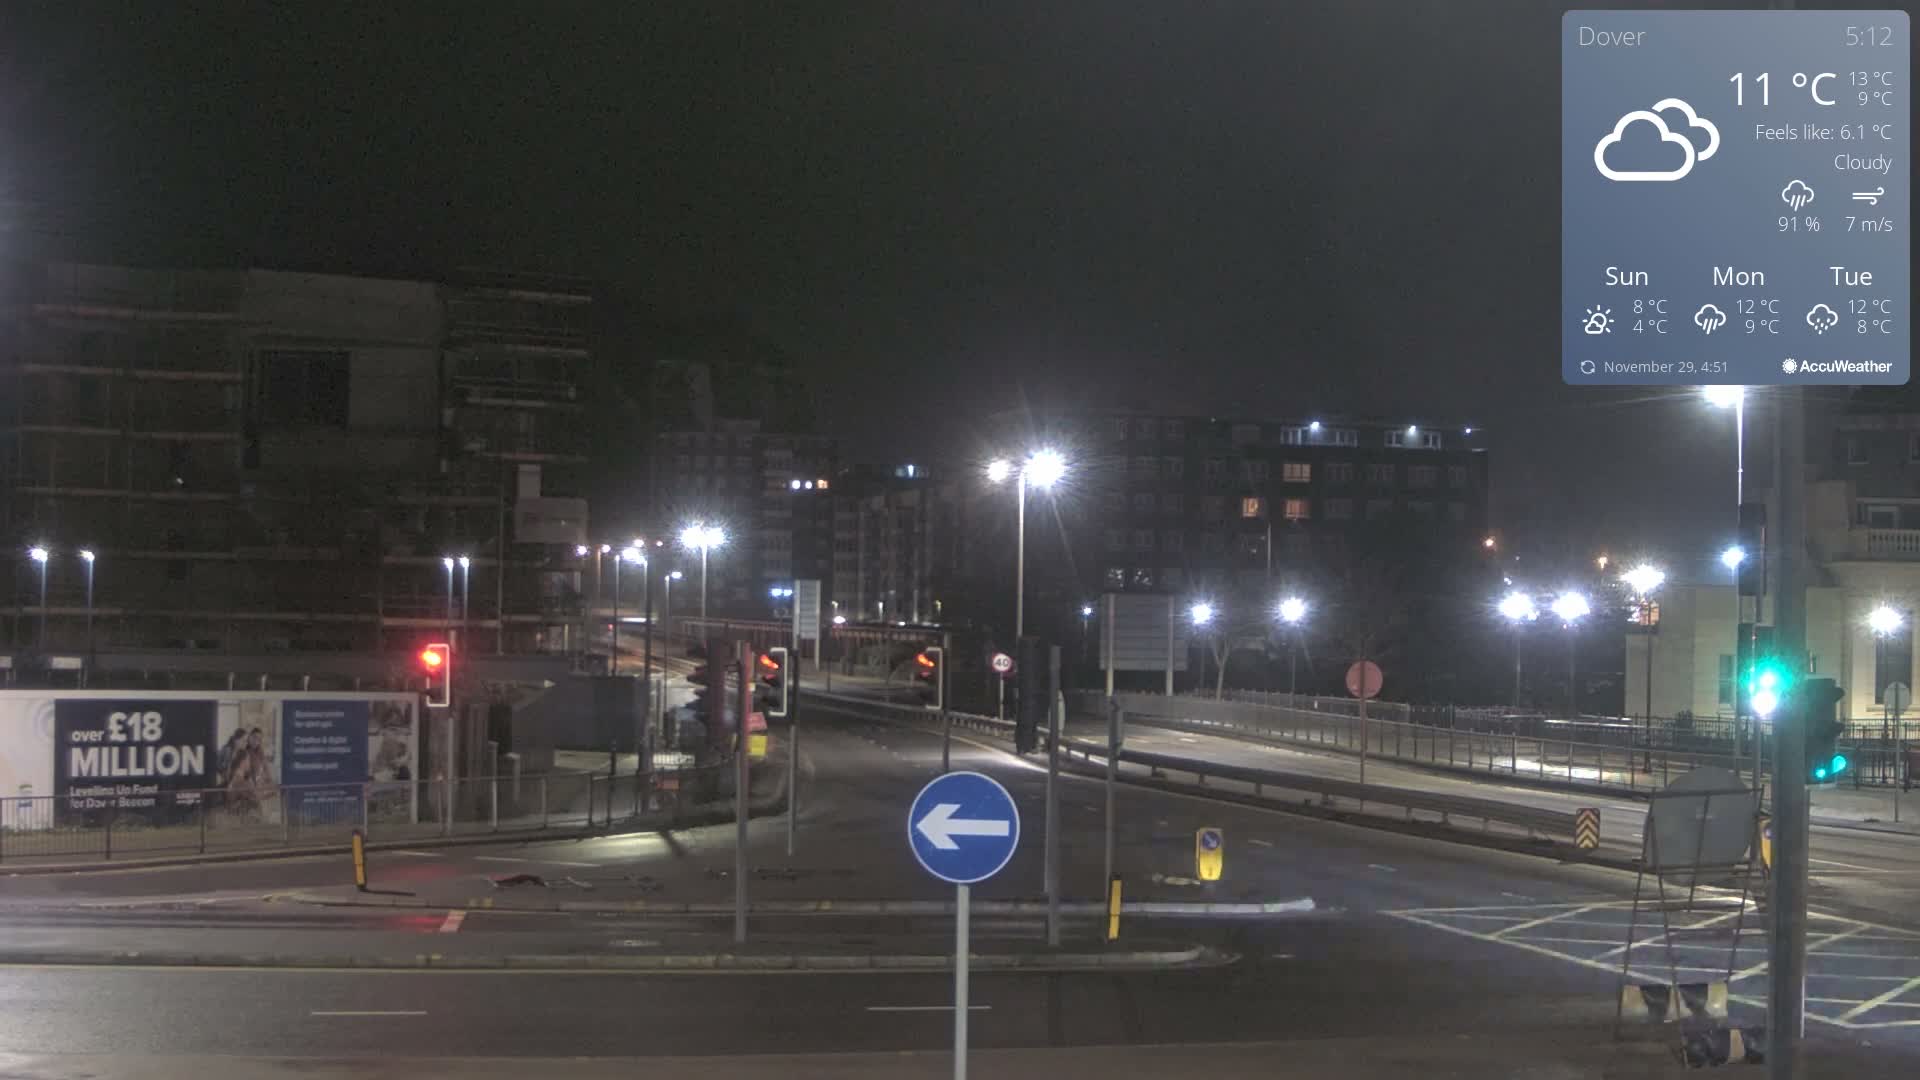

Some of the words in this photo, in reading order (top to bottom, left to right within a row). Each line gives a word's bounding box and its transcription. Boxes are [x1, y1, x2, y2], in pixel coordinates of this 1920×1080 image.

[995, 658, 1009, 667] 40
[71, 730, 104, 742] over
[109, 711, 162, 742] £18
[71, 746, 205, 777] MILLION
